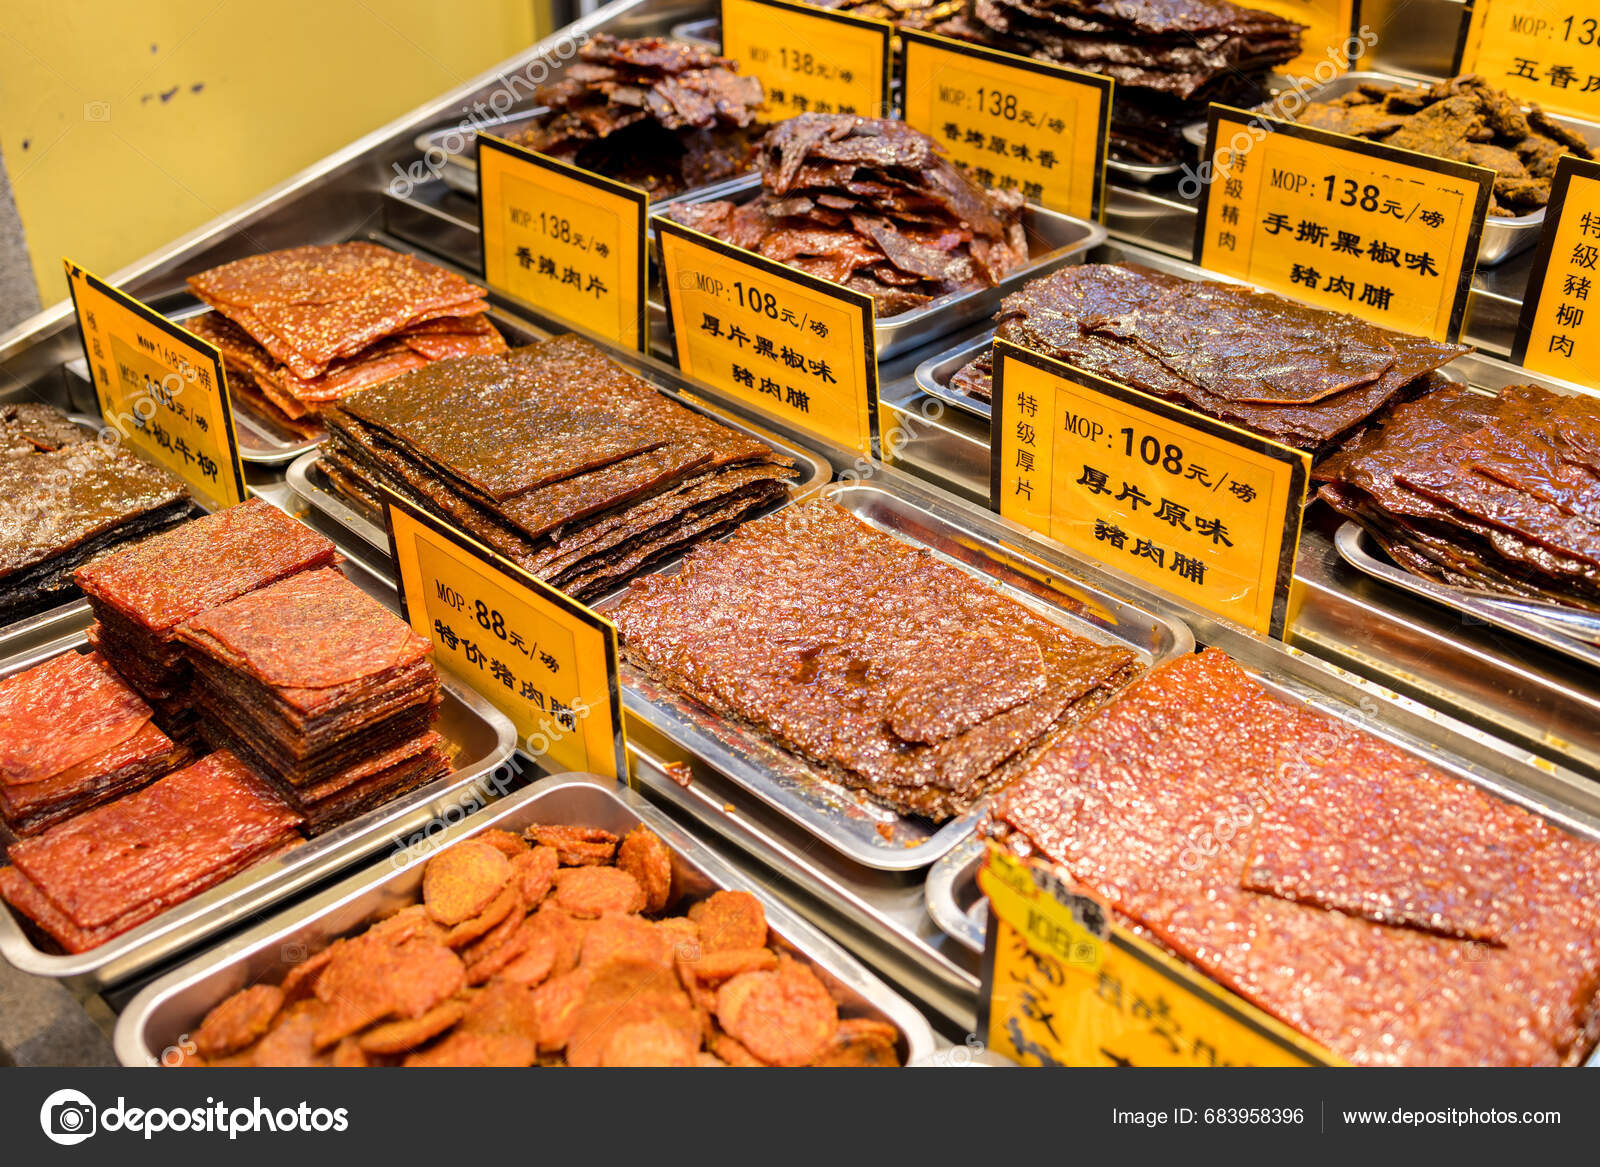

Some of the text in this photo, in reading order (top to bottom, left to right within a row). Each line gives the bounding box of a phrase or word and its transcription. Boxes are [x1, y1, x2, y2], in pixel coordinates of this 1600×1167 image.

[1511, 14, 1600, 47] MOP:13
[1262, 212, 1439, 277] 手撕黑椒味
[1289, 263, 1394, 311] 豬肉脯
[700, 312, 837, 384] 厚片黑椒味
[732, 362, 811, 413] 豬肉脯
[1015, 391, 1038, 501] 特级厚片
[1076, 464, 1234, 547] 厚片原味
[1093, 518, 1208, 585] 豬肉脯
